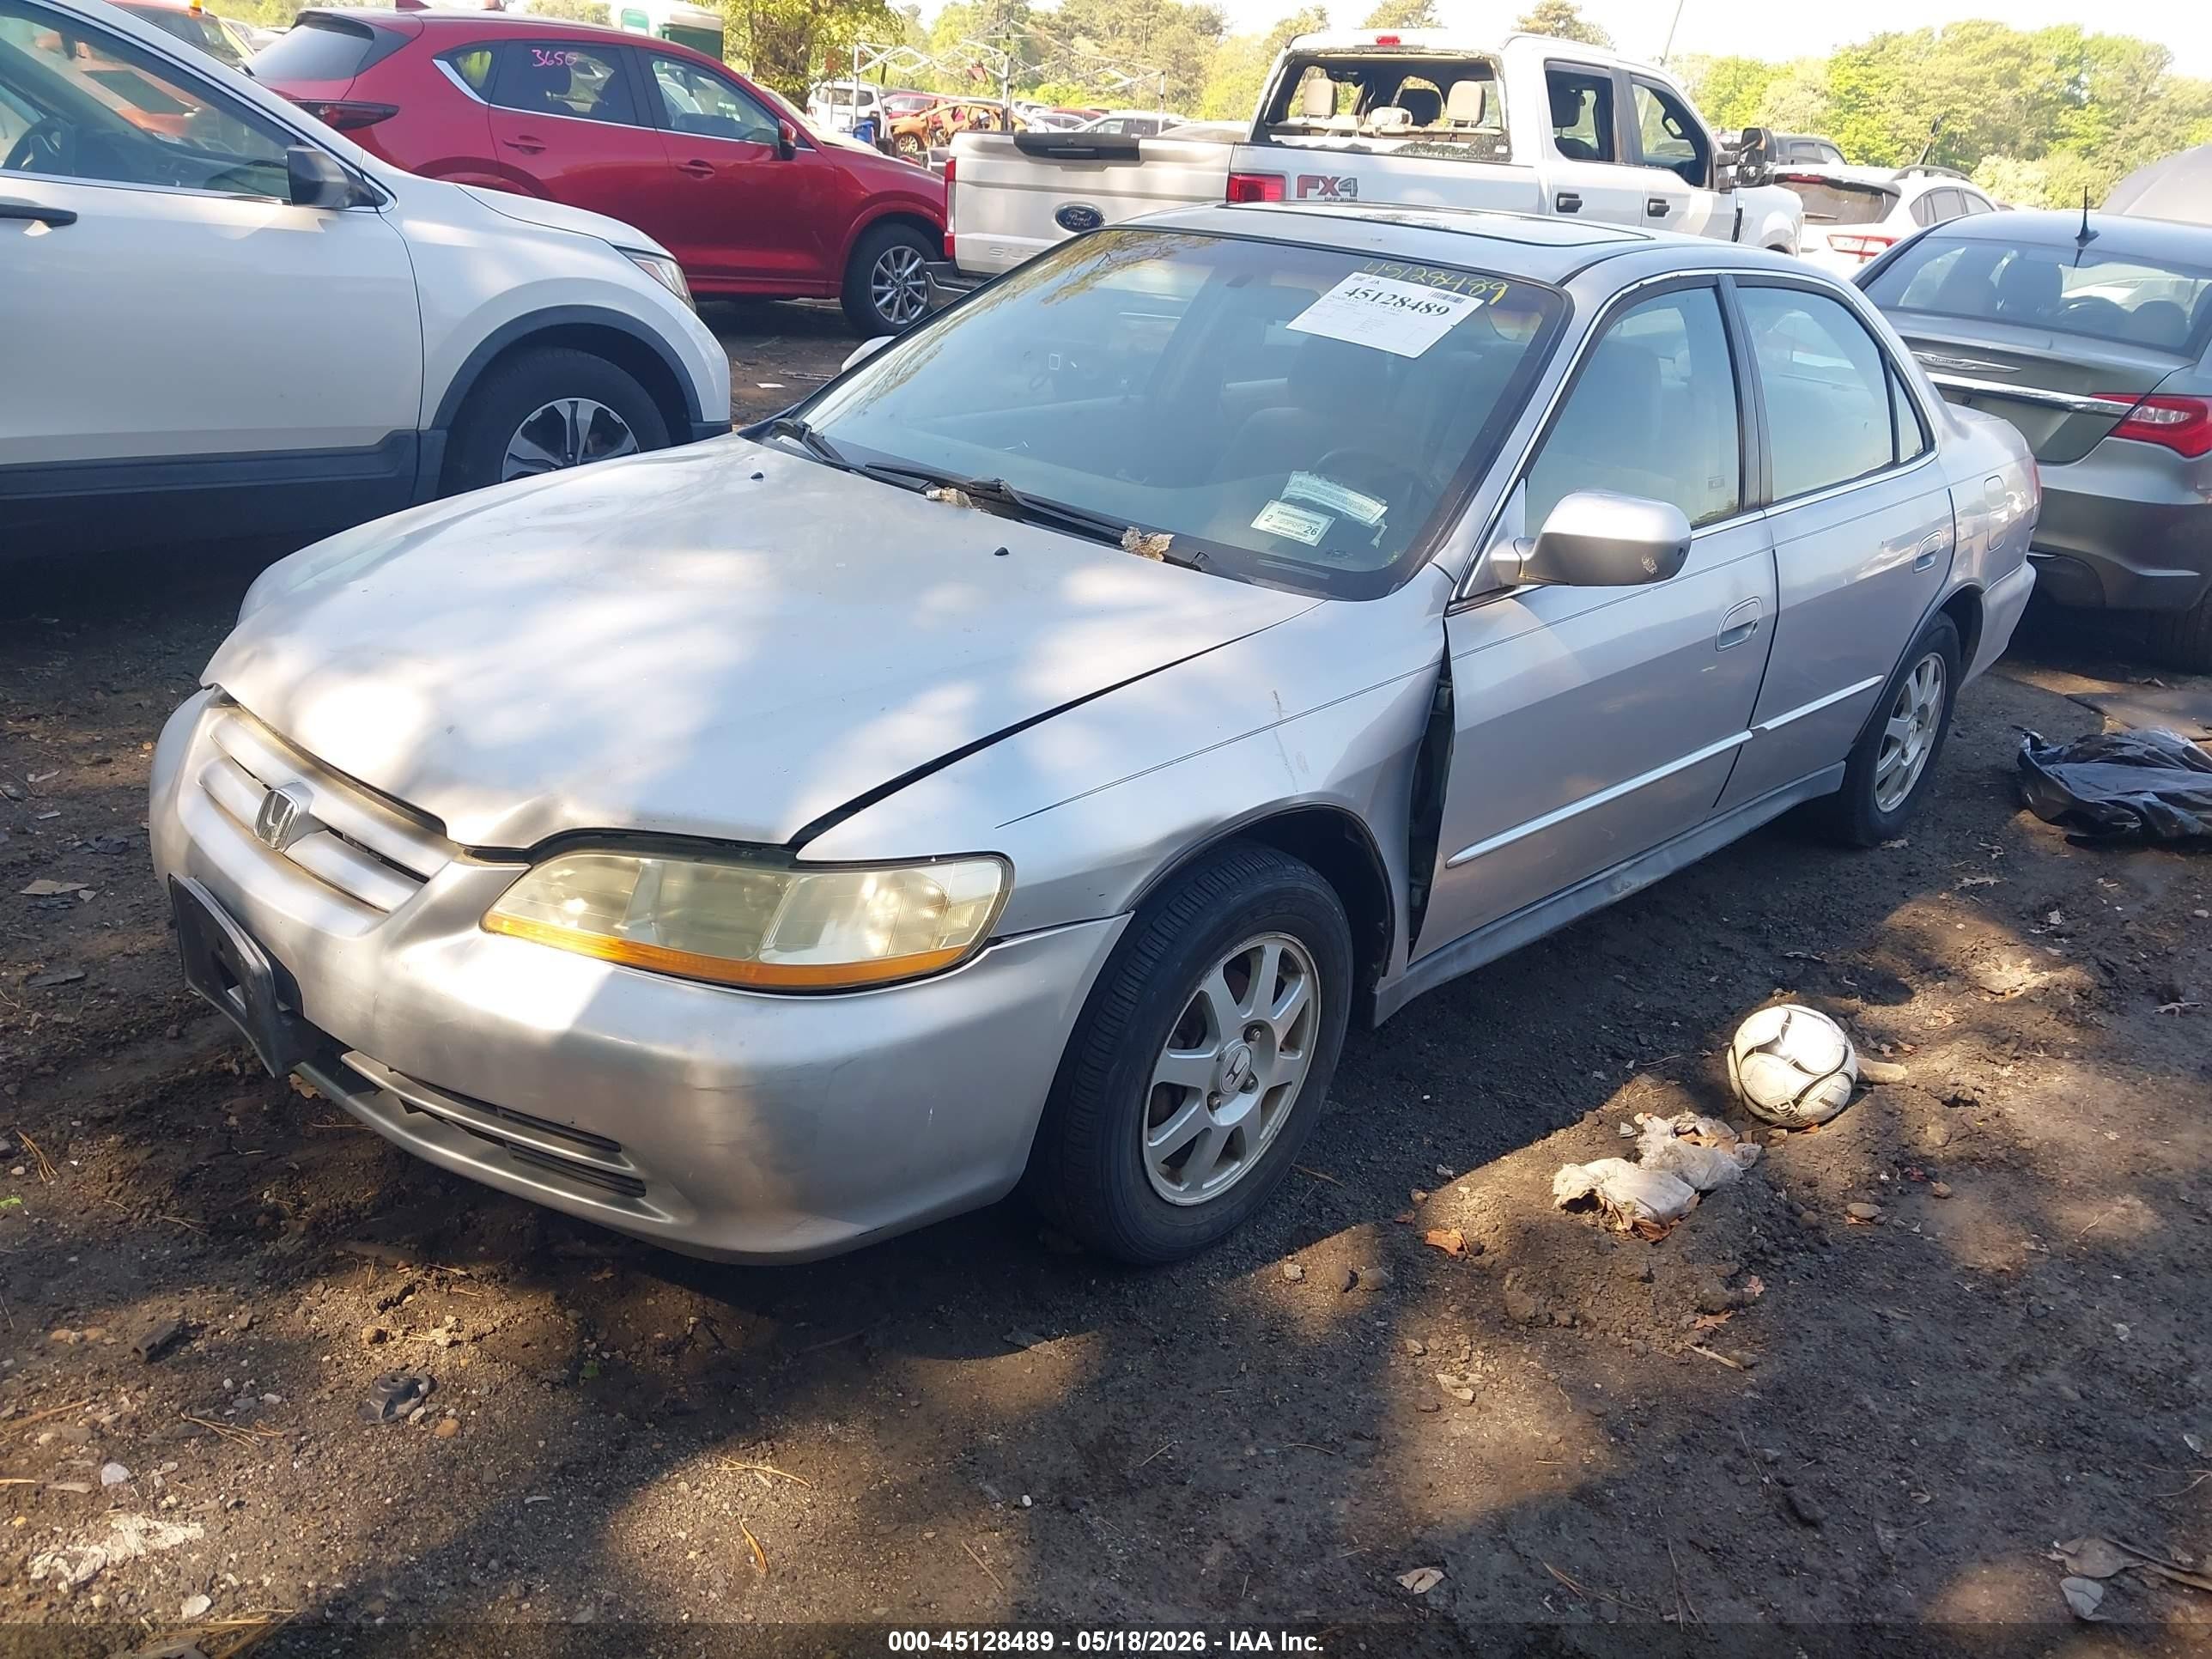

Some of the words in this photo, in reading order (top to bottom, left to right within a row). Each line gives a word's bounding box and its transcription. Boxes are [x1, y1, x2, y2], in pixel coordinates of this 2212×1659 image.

[1297, 174, 1358, 198] FX4
[1066, 209, 1092, 227] Ford
[1344, 287, 1450, 317] 45128489
[1303, 526, 1320, 536] 26
